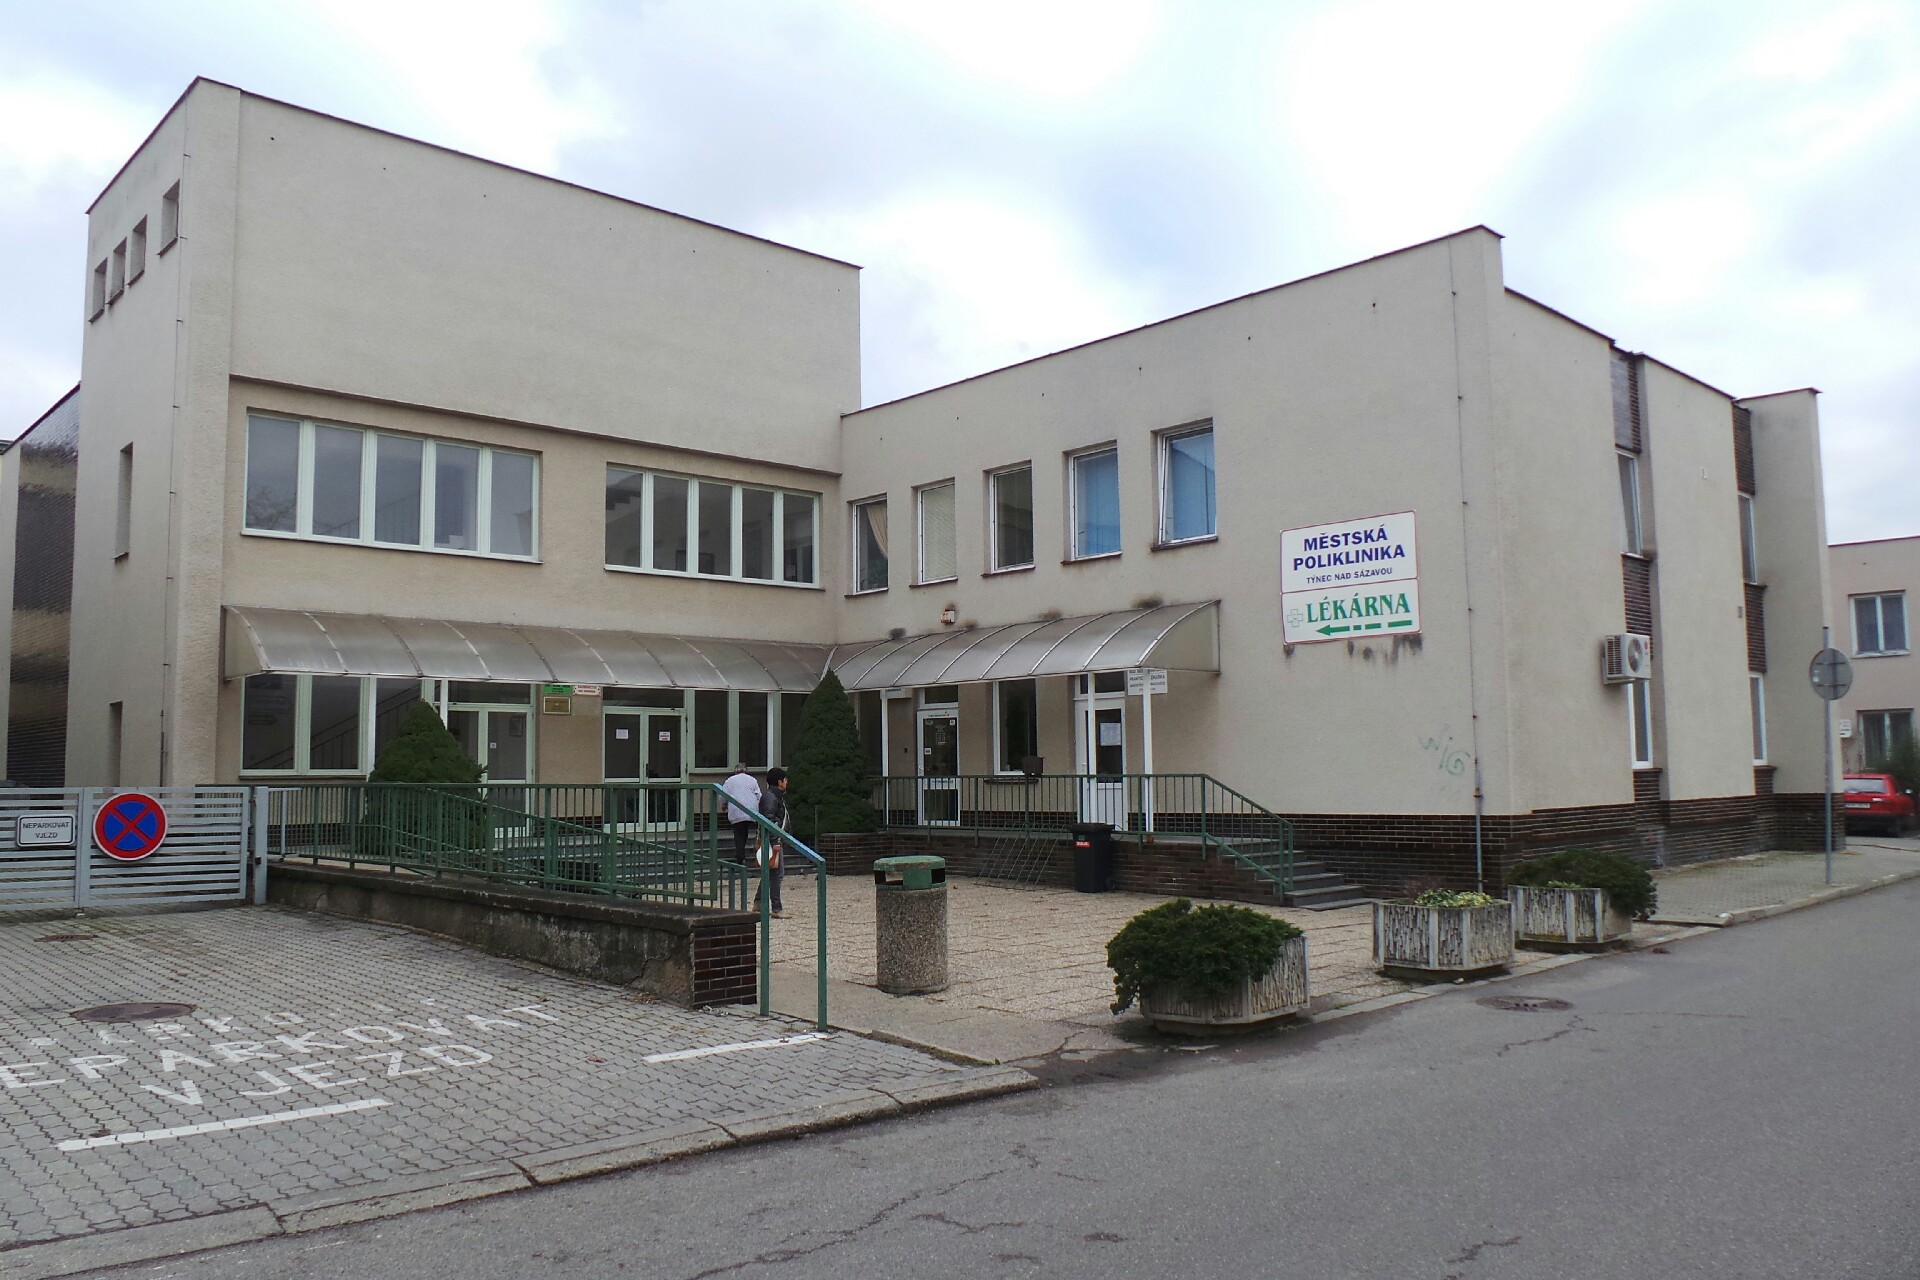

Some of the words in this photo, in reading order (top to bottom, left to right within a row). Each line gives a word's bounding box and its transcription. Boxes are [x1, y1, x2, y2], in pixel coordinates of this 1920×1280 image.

[1303, 523, 1388, 552] MĚSTSKÁ
[1293, 544, 1405, 571] POLIKLINIKA
[1306, 574, 1332, 584] TÝNEC
[1334, 572, 1351, 581] NAD
[1354, 567, 1393, 579] SÁZAVOU
[1306, 592, 1411, 624] LÉKÁRNA
[22, 821, 70, 829] NEPARKOVAT
[138, 1045, 493, 1105] VJEZD
